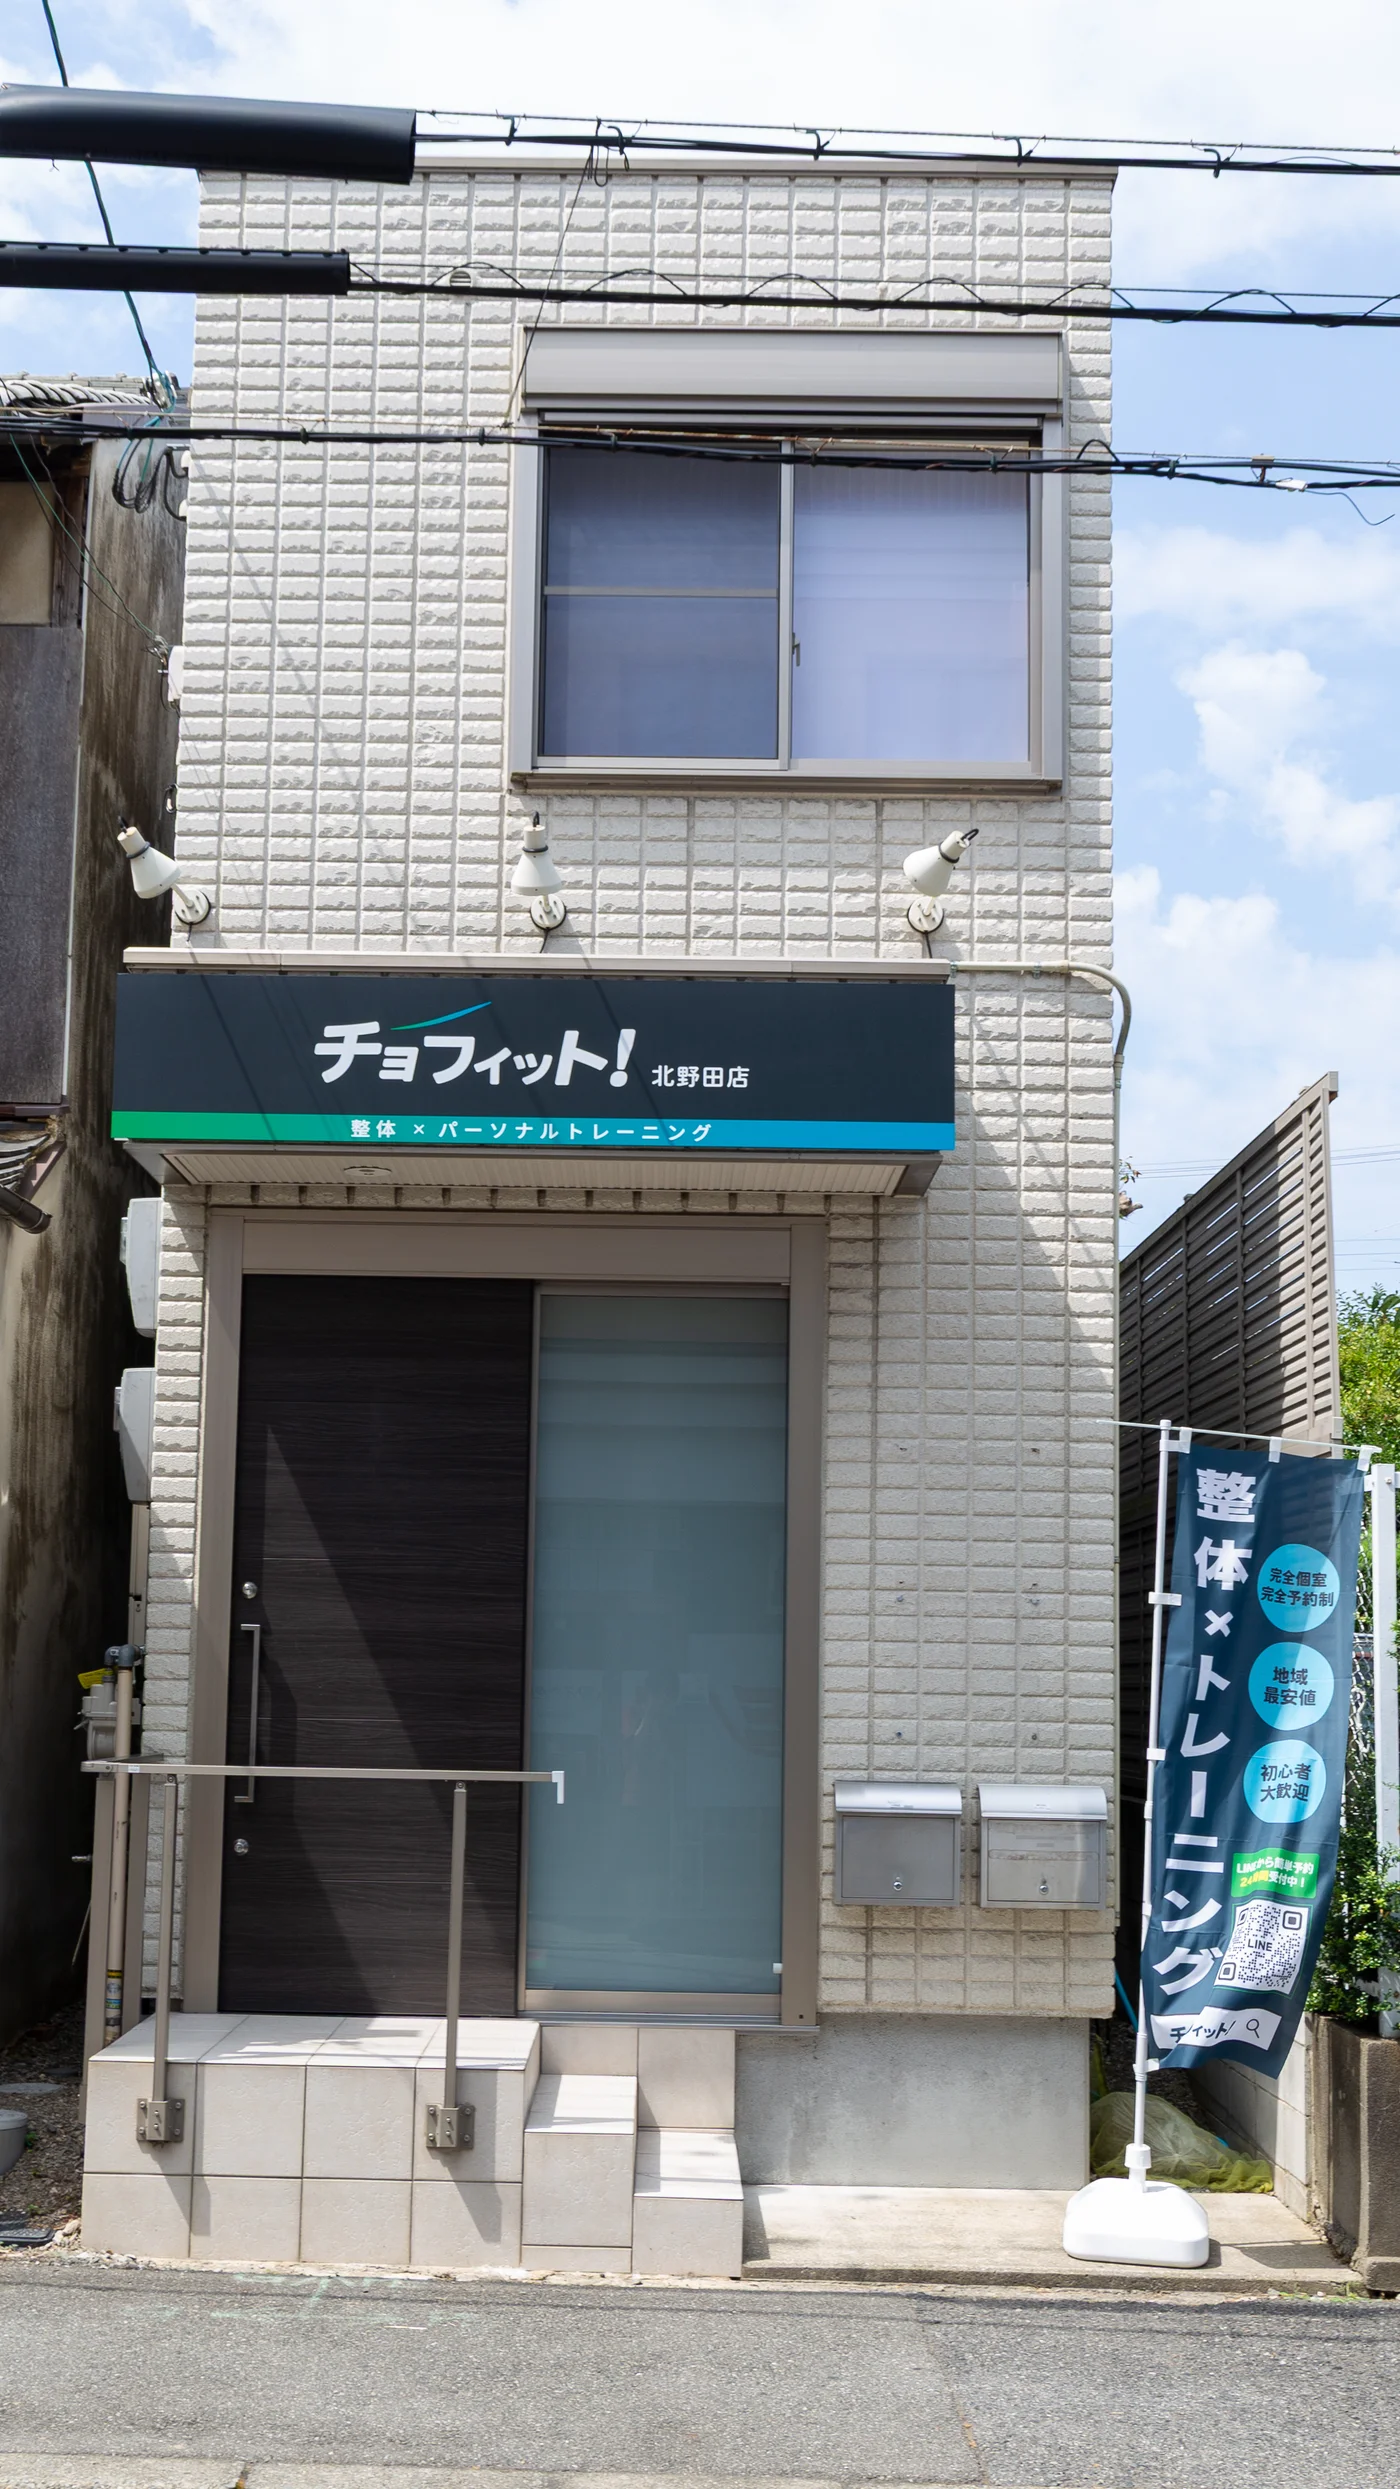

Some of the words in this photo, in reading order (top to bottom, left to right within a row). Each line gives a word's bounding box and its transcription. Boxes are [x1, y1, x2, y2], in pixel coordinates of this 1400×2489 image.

[314, 1021, 636, 1088] チョフィット!
[651, 1065, 749, 1088] 北野田店
[1270, 1568, 1327, 1587] 完全個室
[1261, 1586, 1334, 1607] 完全予約制
[1273, 1666, 1308, 1685] 地域
[1264, 1686, 1317, 1706] 最安値
[1261, 1763, 1312, 1782] 初心者
[1260, 1783, 1309, 1802] 大歓迎
[1247, 1938, 1273, 1952] LINE
